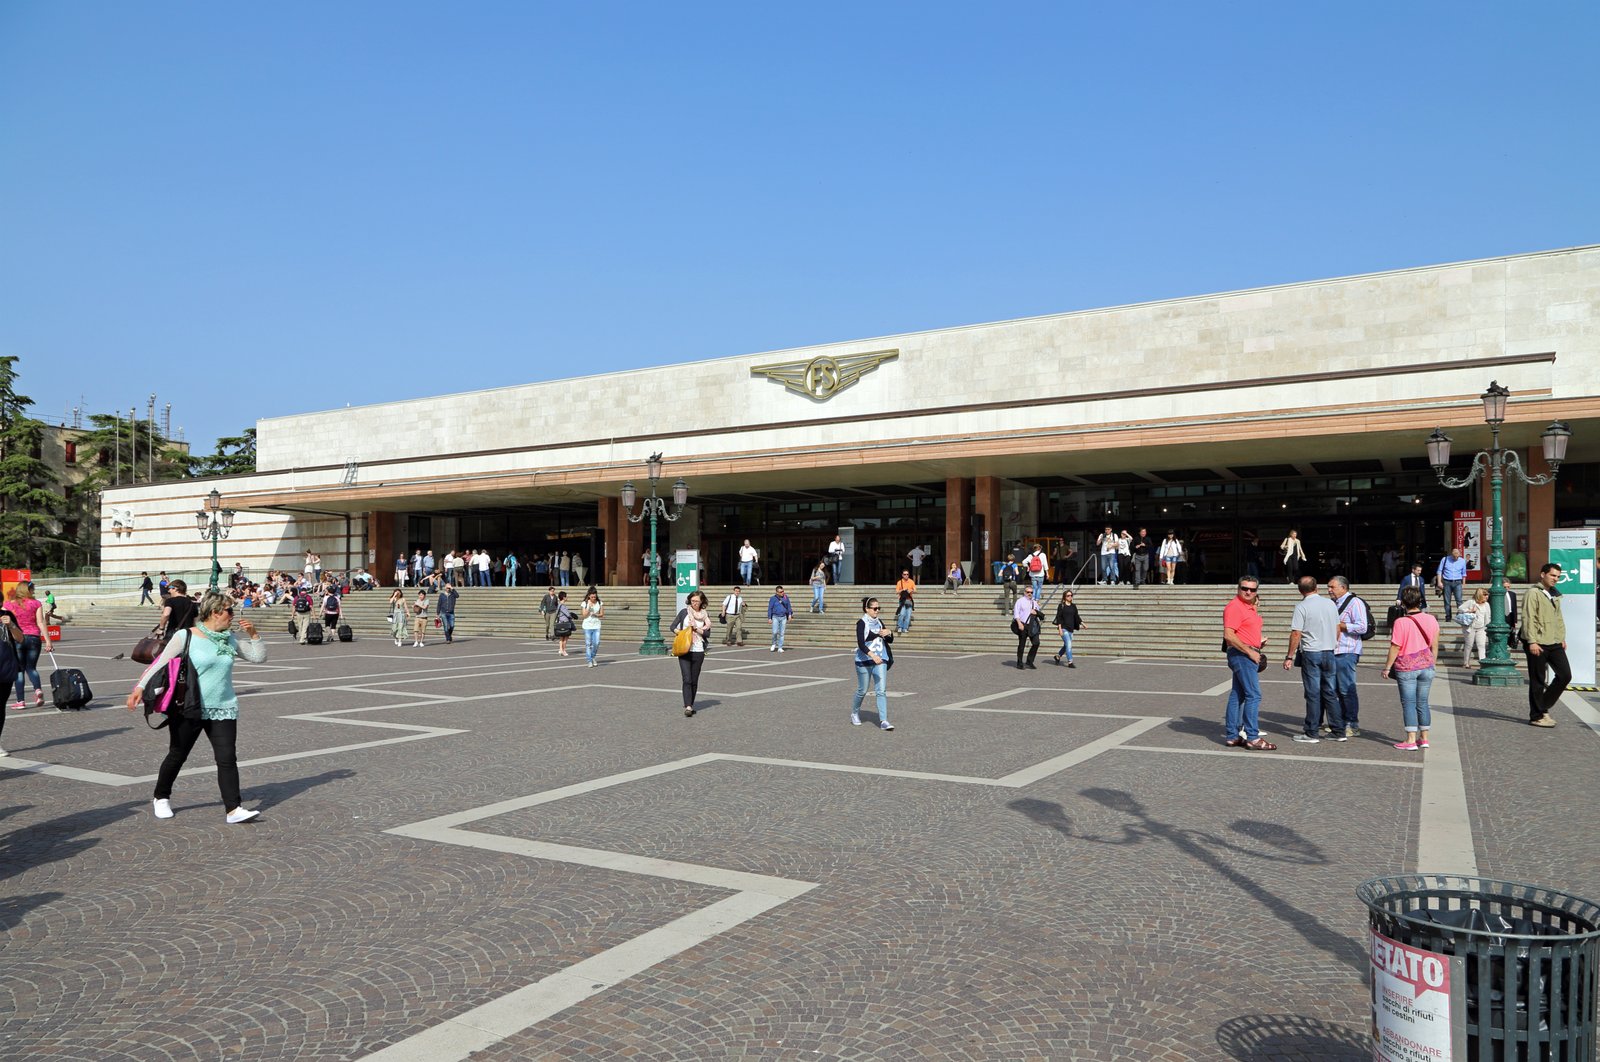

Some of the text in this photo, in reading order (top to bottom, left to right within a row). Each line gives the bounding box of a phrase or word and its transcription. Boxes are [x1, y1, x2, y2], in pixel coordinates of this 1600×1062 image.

[811, 363, 836, 392] FS
[1382, 986, 1414, 1006] INSERIRE
[1382, 995, 1434, 1021] sacchi di rifiuti
[1391, 1009, 1415, 1023] cestini
[1382, 1026, 1442, 1057] ABBANDONARE
[1382, 1035, 1402, 1050] sacchi
[1409, 1049, 1431, 1062] rifiuti
